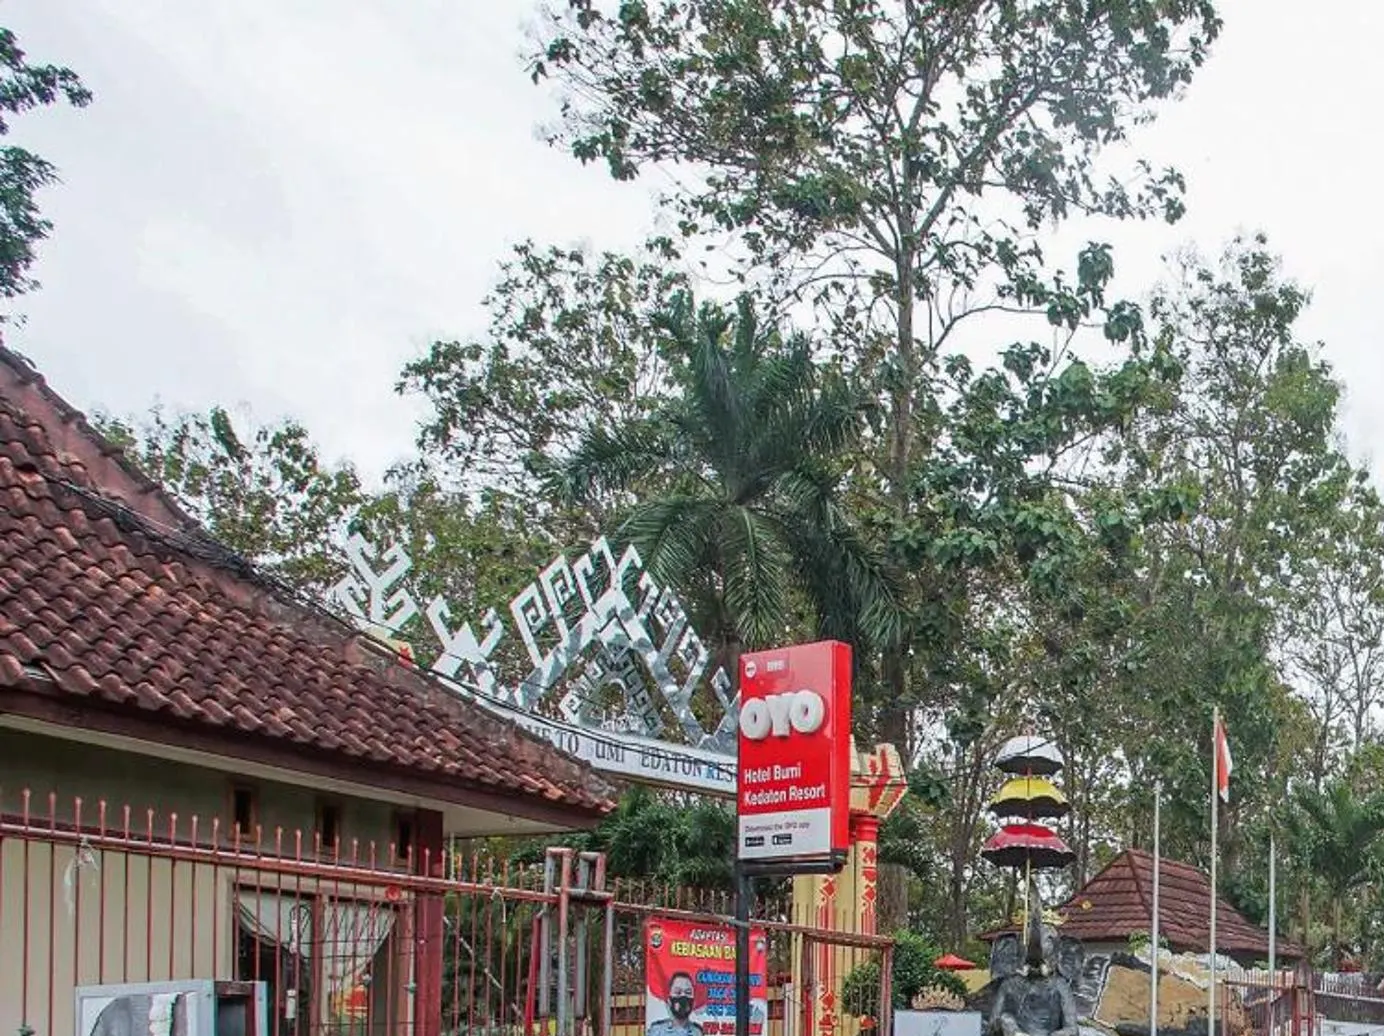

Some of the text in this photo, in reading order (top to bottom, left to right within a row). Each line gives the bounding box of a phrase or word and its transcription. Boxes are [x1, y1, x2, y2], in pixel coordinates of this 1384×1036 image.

[739, 689, 825, 740] OYO
[744, 763, 801, 784] Hotel Bumi
[744, 784, 826, 806] Kedaton Resort
